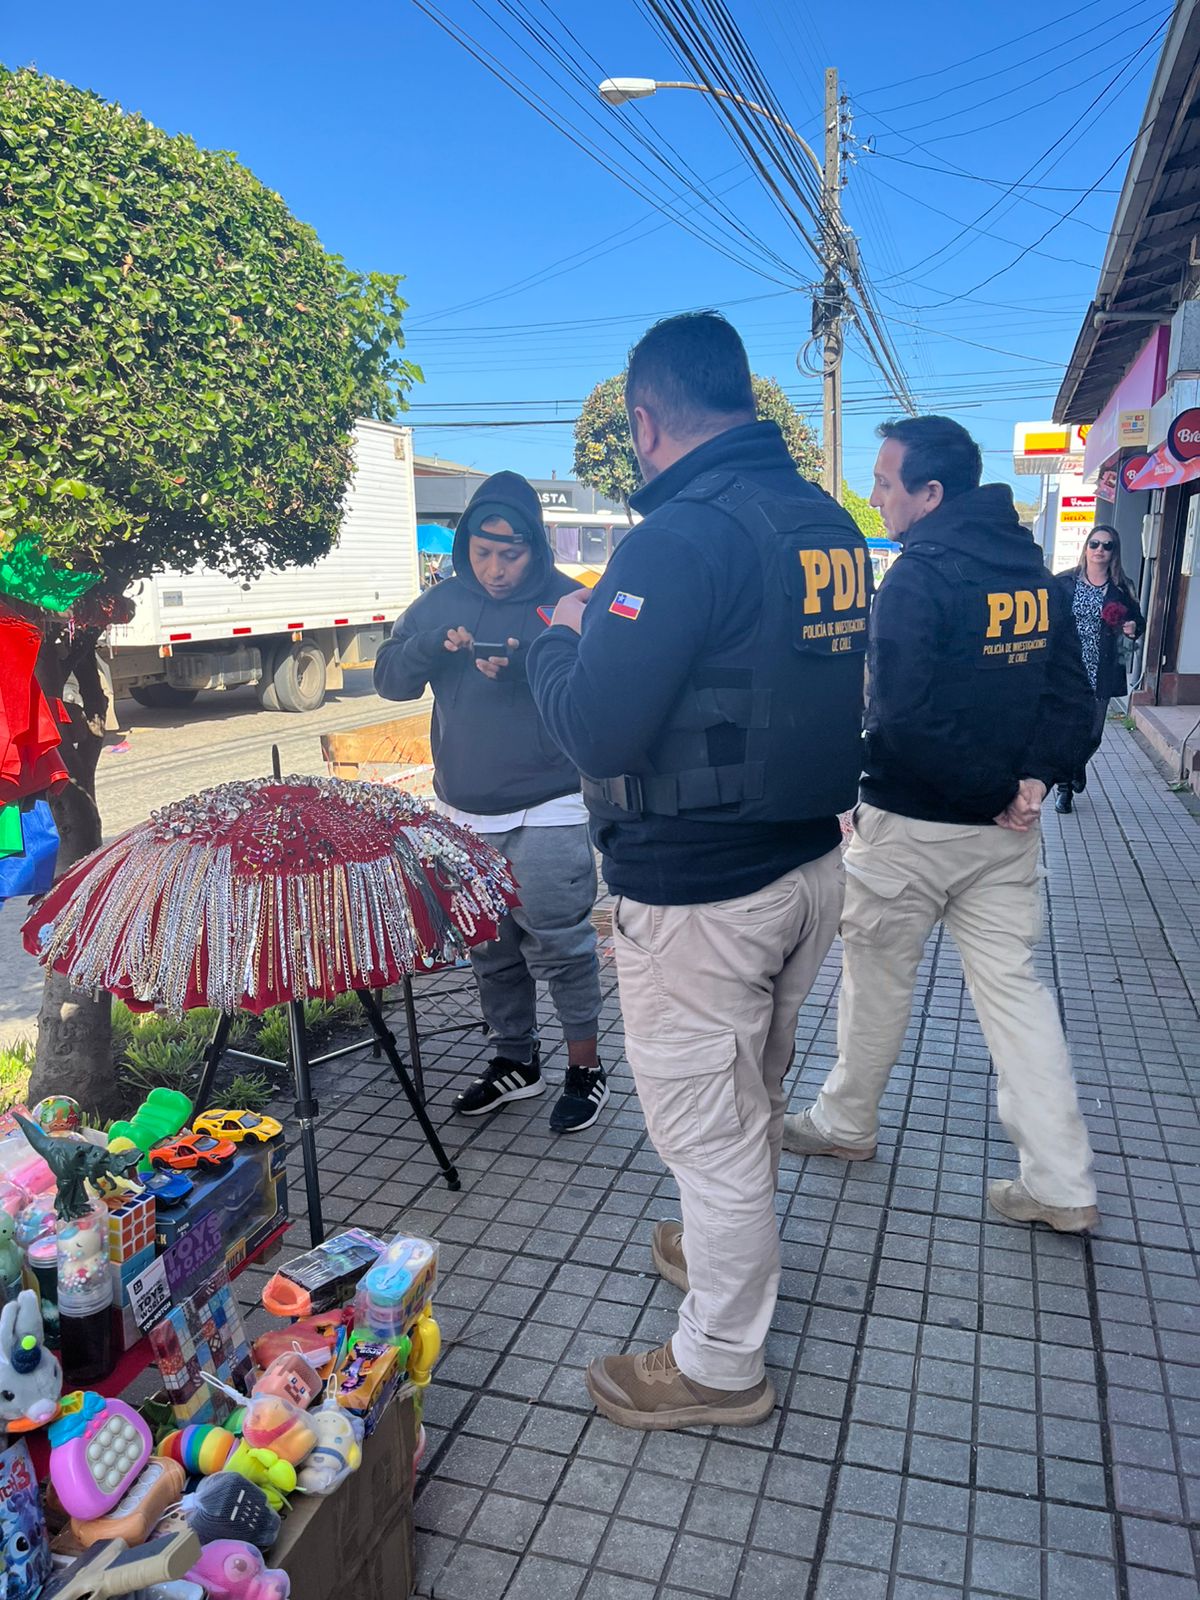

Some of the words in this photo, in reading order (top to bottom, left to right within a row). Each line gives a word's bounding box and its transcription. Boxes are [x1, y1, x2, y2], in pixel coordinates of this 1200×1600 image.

[799, 548, 866, 614] PDI
[986, 588, 1049, 638] PDI
[828, 622, 834, 637] DE
[832, 637, 839, 653] DE
[839, 635, 852, 651] CHILE
[1005, 642, 1012, 653] DE
[1008, 652, 1015, 664] DE
[1015, 651, 1028, 663] CHILE
[164, 1213, 222, 1270] TOYS
[167, 1230, 222, 1284] WORLD
[138, 1283, 164, 1311] TOYS
[140, 1294, 164, 1320] WORLD
[143, 1301, 172, 1332] TOP-NOTCH
